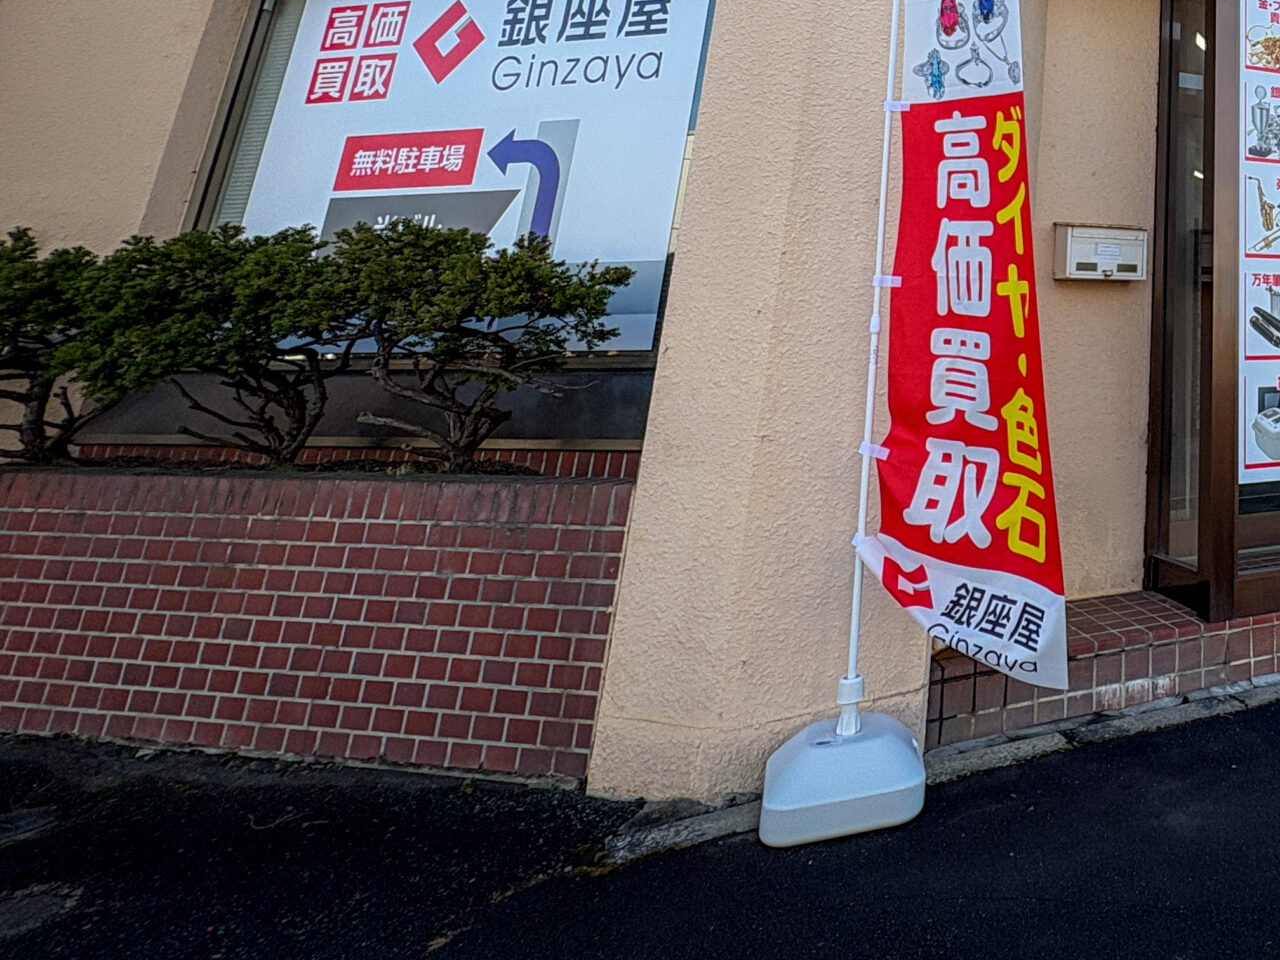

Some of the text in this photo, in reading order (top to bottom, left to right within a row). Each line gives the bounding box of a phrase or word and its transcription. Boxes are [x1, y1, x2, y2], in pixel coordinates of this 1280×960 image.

[324, 5, 408, 50] 高価
[309, 56, 391, 100] 買取
[492, 50, 664, 91] Ginzaya
[350, 144, 465, 177] 無料駐車場
[903, 110, 1000, 548] 高価買取
[992, 105, 1047, 564] ダイヤ・色石
[940, 582, 1046, 653] 銀座屋
